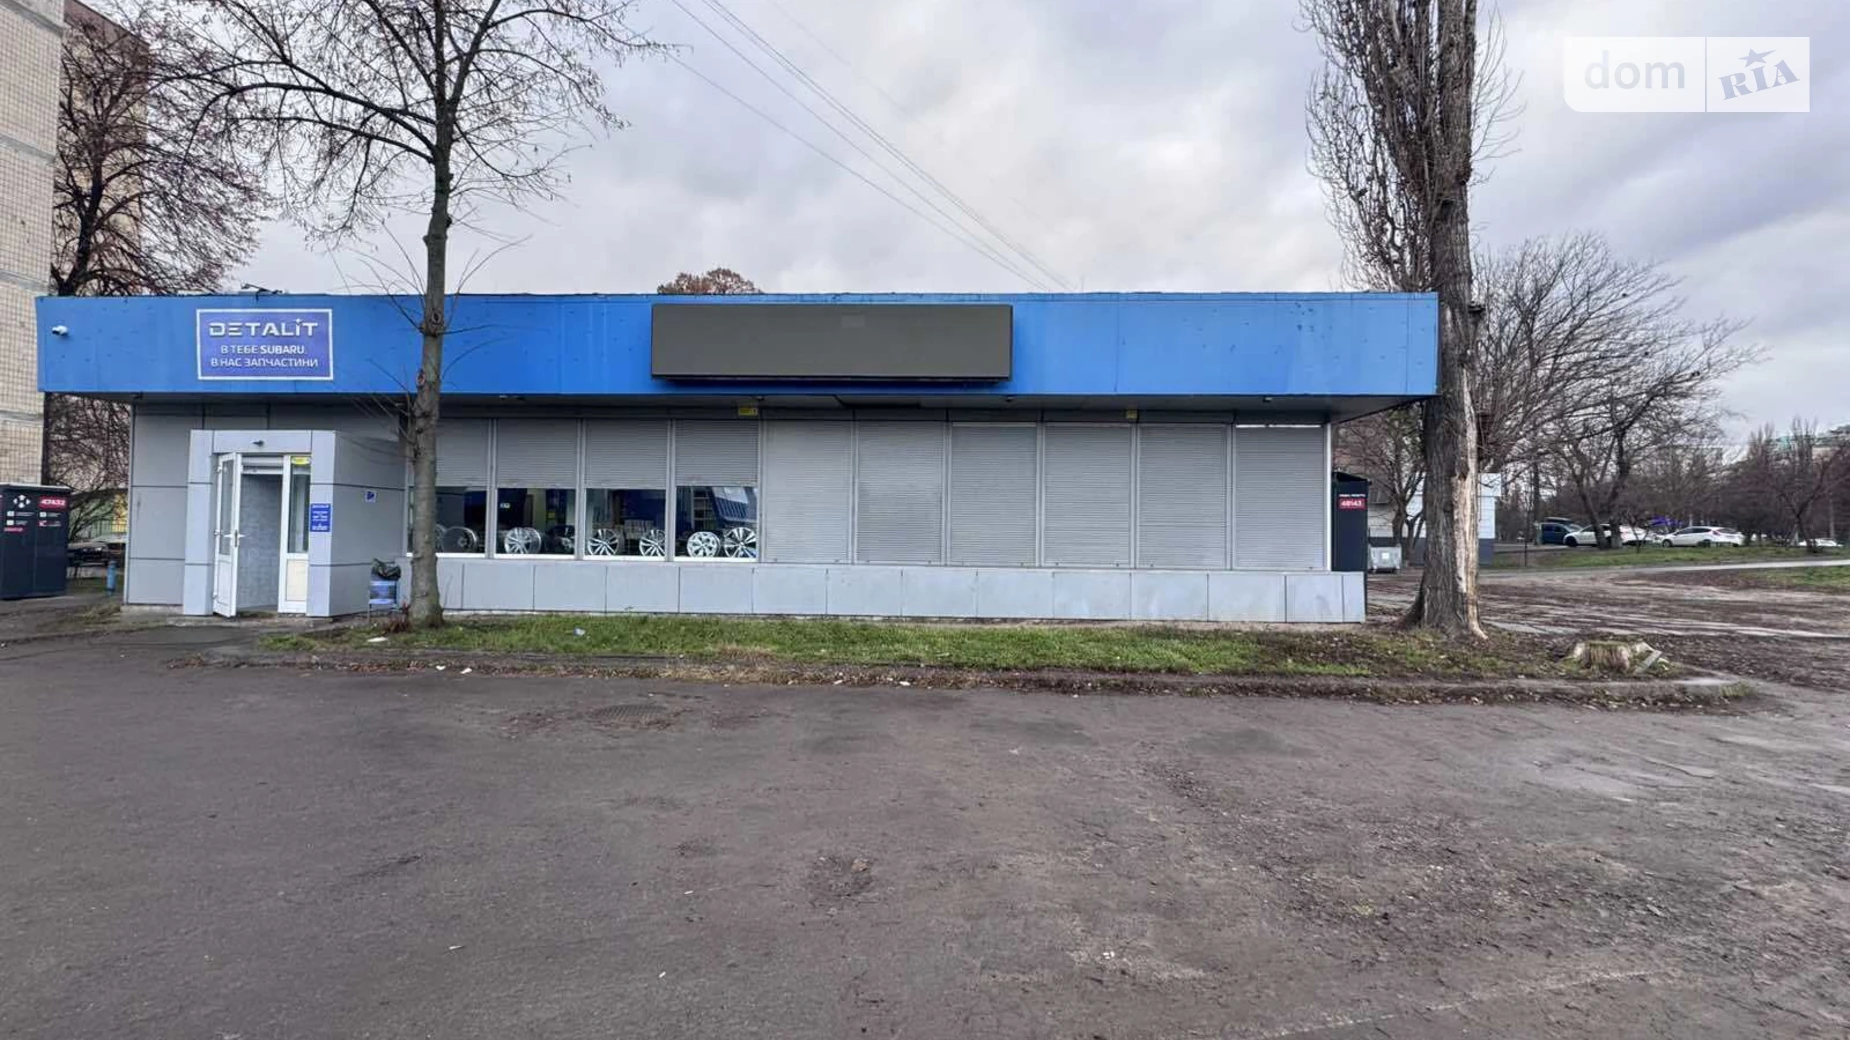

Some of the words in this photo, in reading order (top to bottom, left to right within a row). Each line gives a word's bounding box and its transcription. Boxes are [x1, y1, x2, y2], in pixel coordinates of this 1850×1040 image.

[220, 344, 229, 354] В
[231, 344, 259, 354] ТЕБЕ
[210, 358, 219, 368] В
[220, 358, 243, 368] НАС
[244, 358, 319, 368] ЗАПЧАСТИНИ
